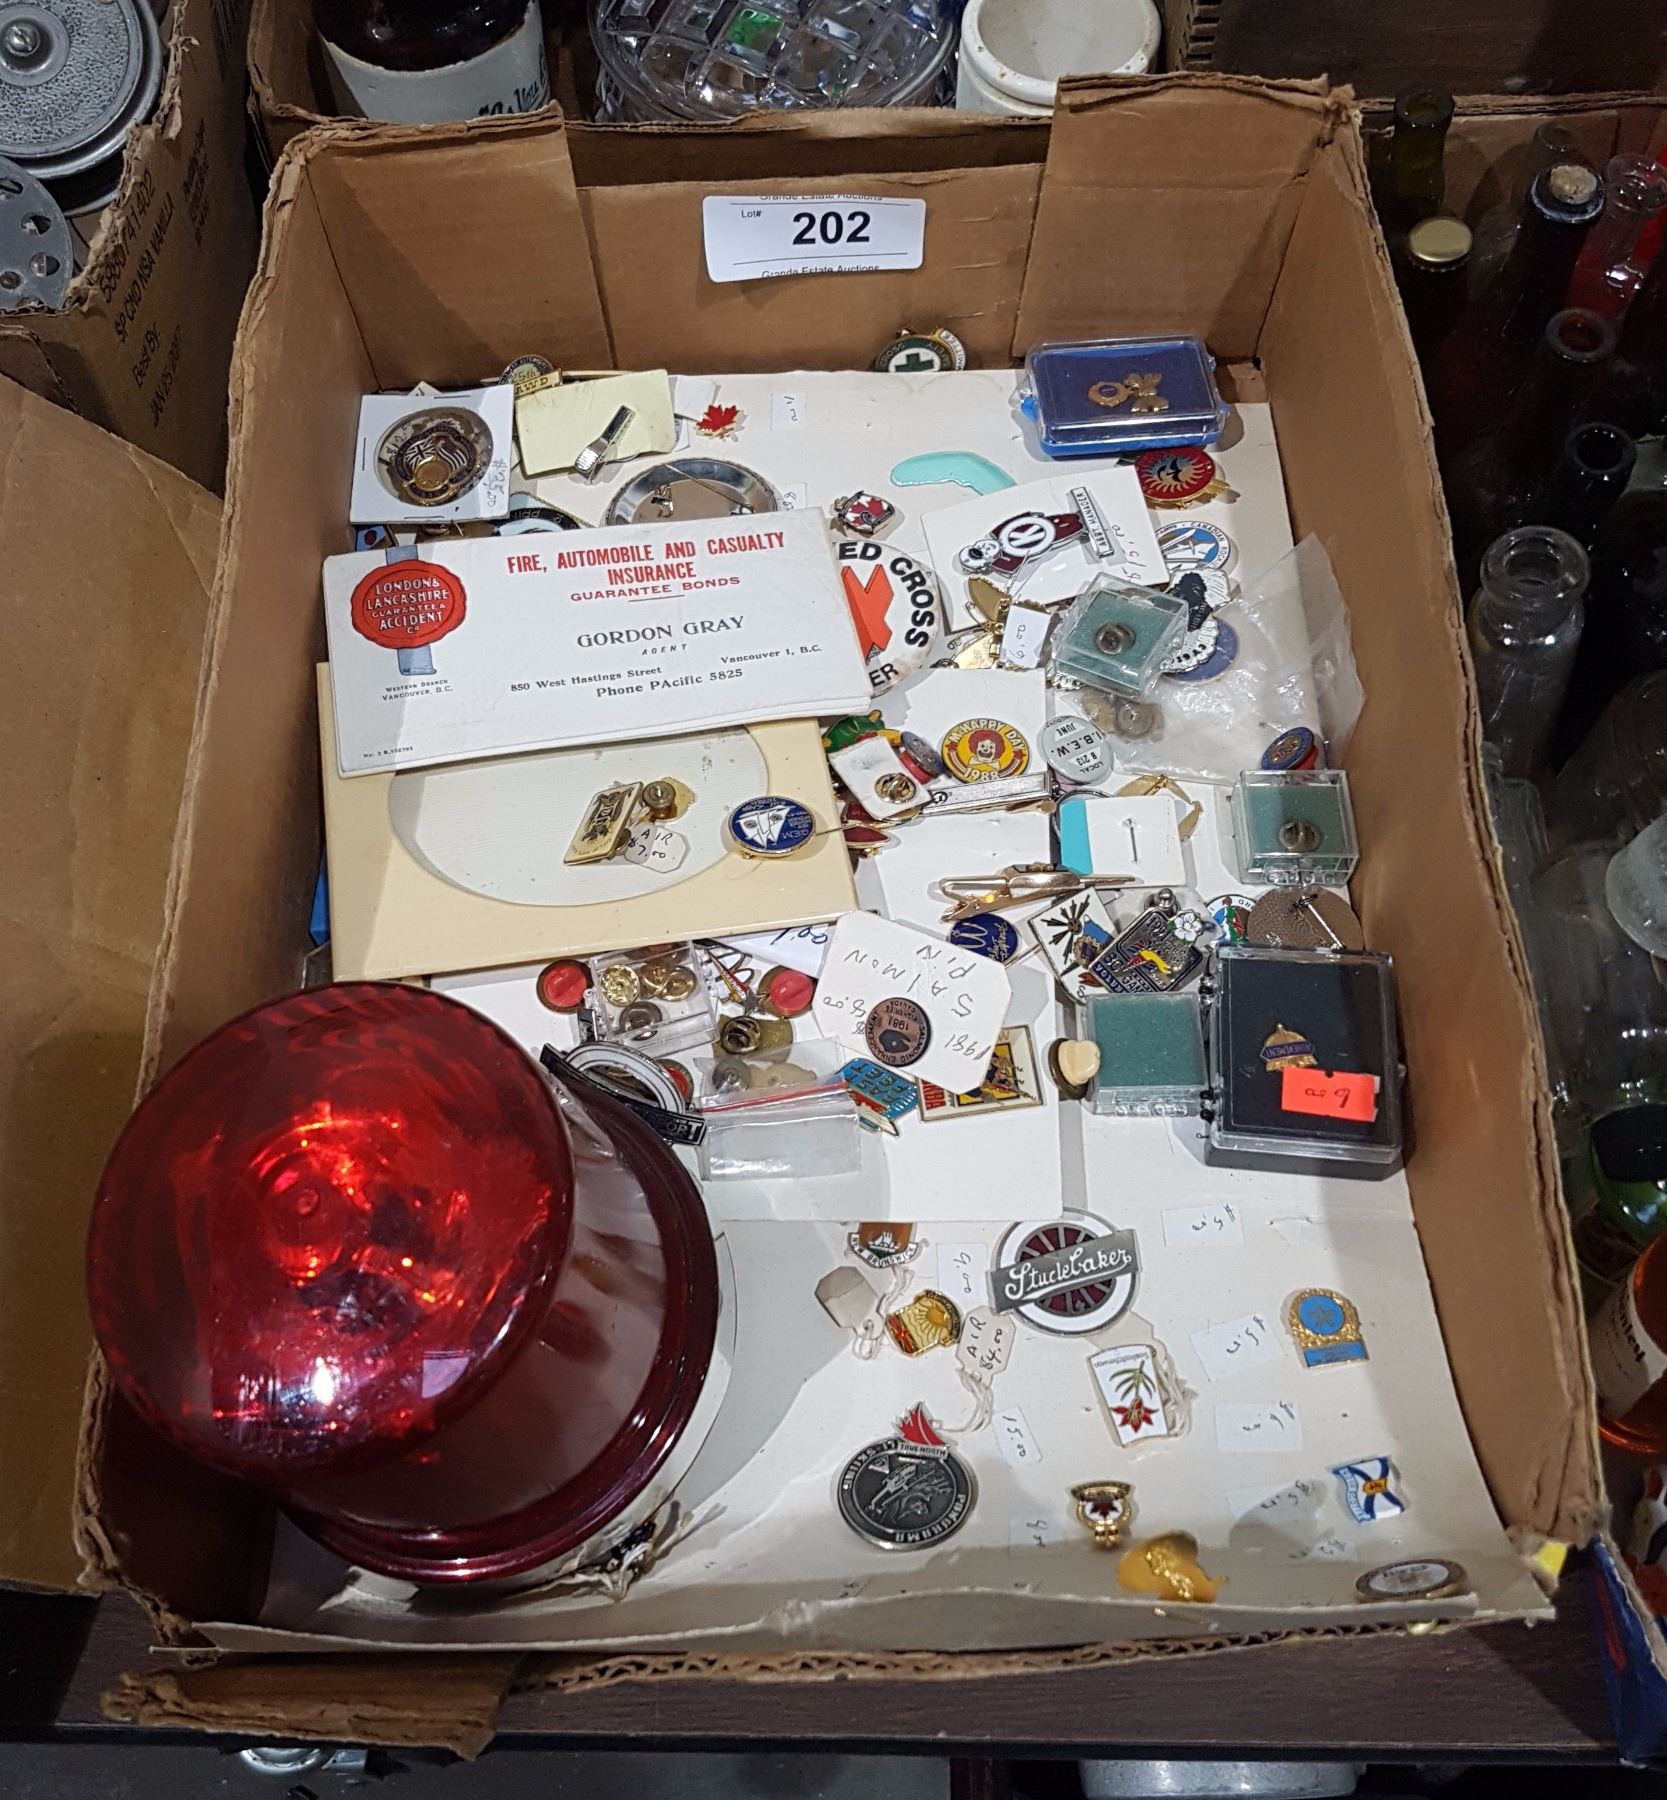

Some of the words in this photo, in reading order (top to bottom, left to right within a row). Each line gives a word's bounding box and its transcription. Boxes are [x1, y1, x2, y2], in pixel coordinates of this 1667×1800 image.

[741, 210, 761, 218] Lot#
[792, 211, 871, 246] 202
[507, 554, 548, 573] FIRE,
[557, 544, 654, 569] AUTOMOBILE
[665, 541, 696, 559] AND
[707, 532, 785, 556] CASUALTY
[608, 562, 696, 585] INSURANCE
[366, 589, 450, 610] LANCASHIRE
[571, 584, 672, 602] GUARANTEE
[682, 577, 740, 591] BONDS
[838, 541, 882, 561] ED
[889, 557, 935, 648] CROSS
[379, 611, 443, 630] ACCIDENT
[577, 625, 672, 648] GORDON
[683, 616, 745, 636] GRAY
[641, 643, 688, 655] AGENT
[720, 649, 781, 664] Vancouver
[799, 643, 823, 654] B.C.
[510, 681, 531, 692] 850
[536, 676, 567, 689] West
[571, 671, 622, 686] Hastings
[627, 666, 662, 679] Street
[596, 683, 644, 698] Phone
[650, 673, 703, 691] PAcific
[709, 668, 744, 682] 5825
[948, 719, 1003, 744] McHAPPY
[1005, 730, 1027, 751] DAY
[1055, 721, 1077, 738] JUNE
[1077, 756, 1094, 767] 213
[1078, 761, 1104, 774] LOCAL
[963, 767, 1001, 782] 1988
[887, 1014, 910, 1031] 1981
[1004, 1247, 1133, 1300] Studebaker
